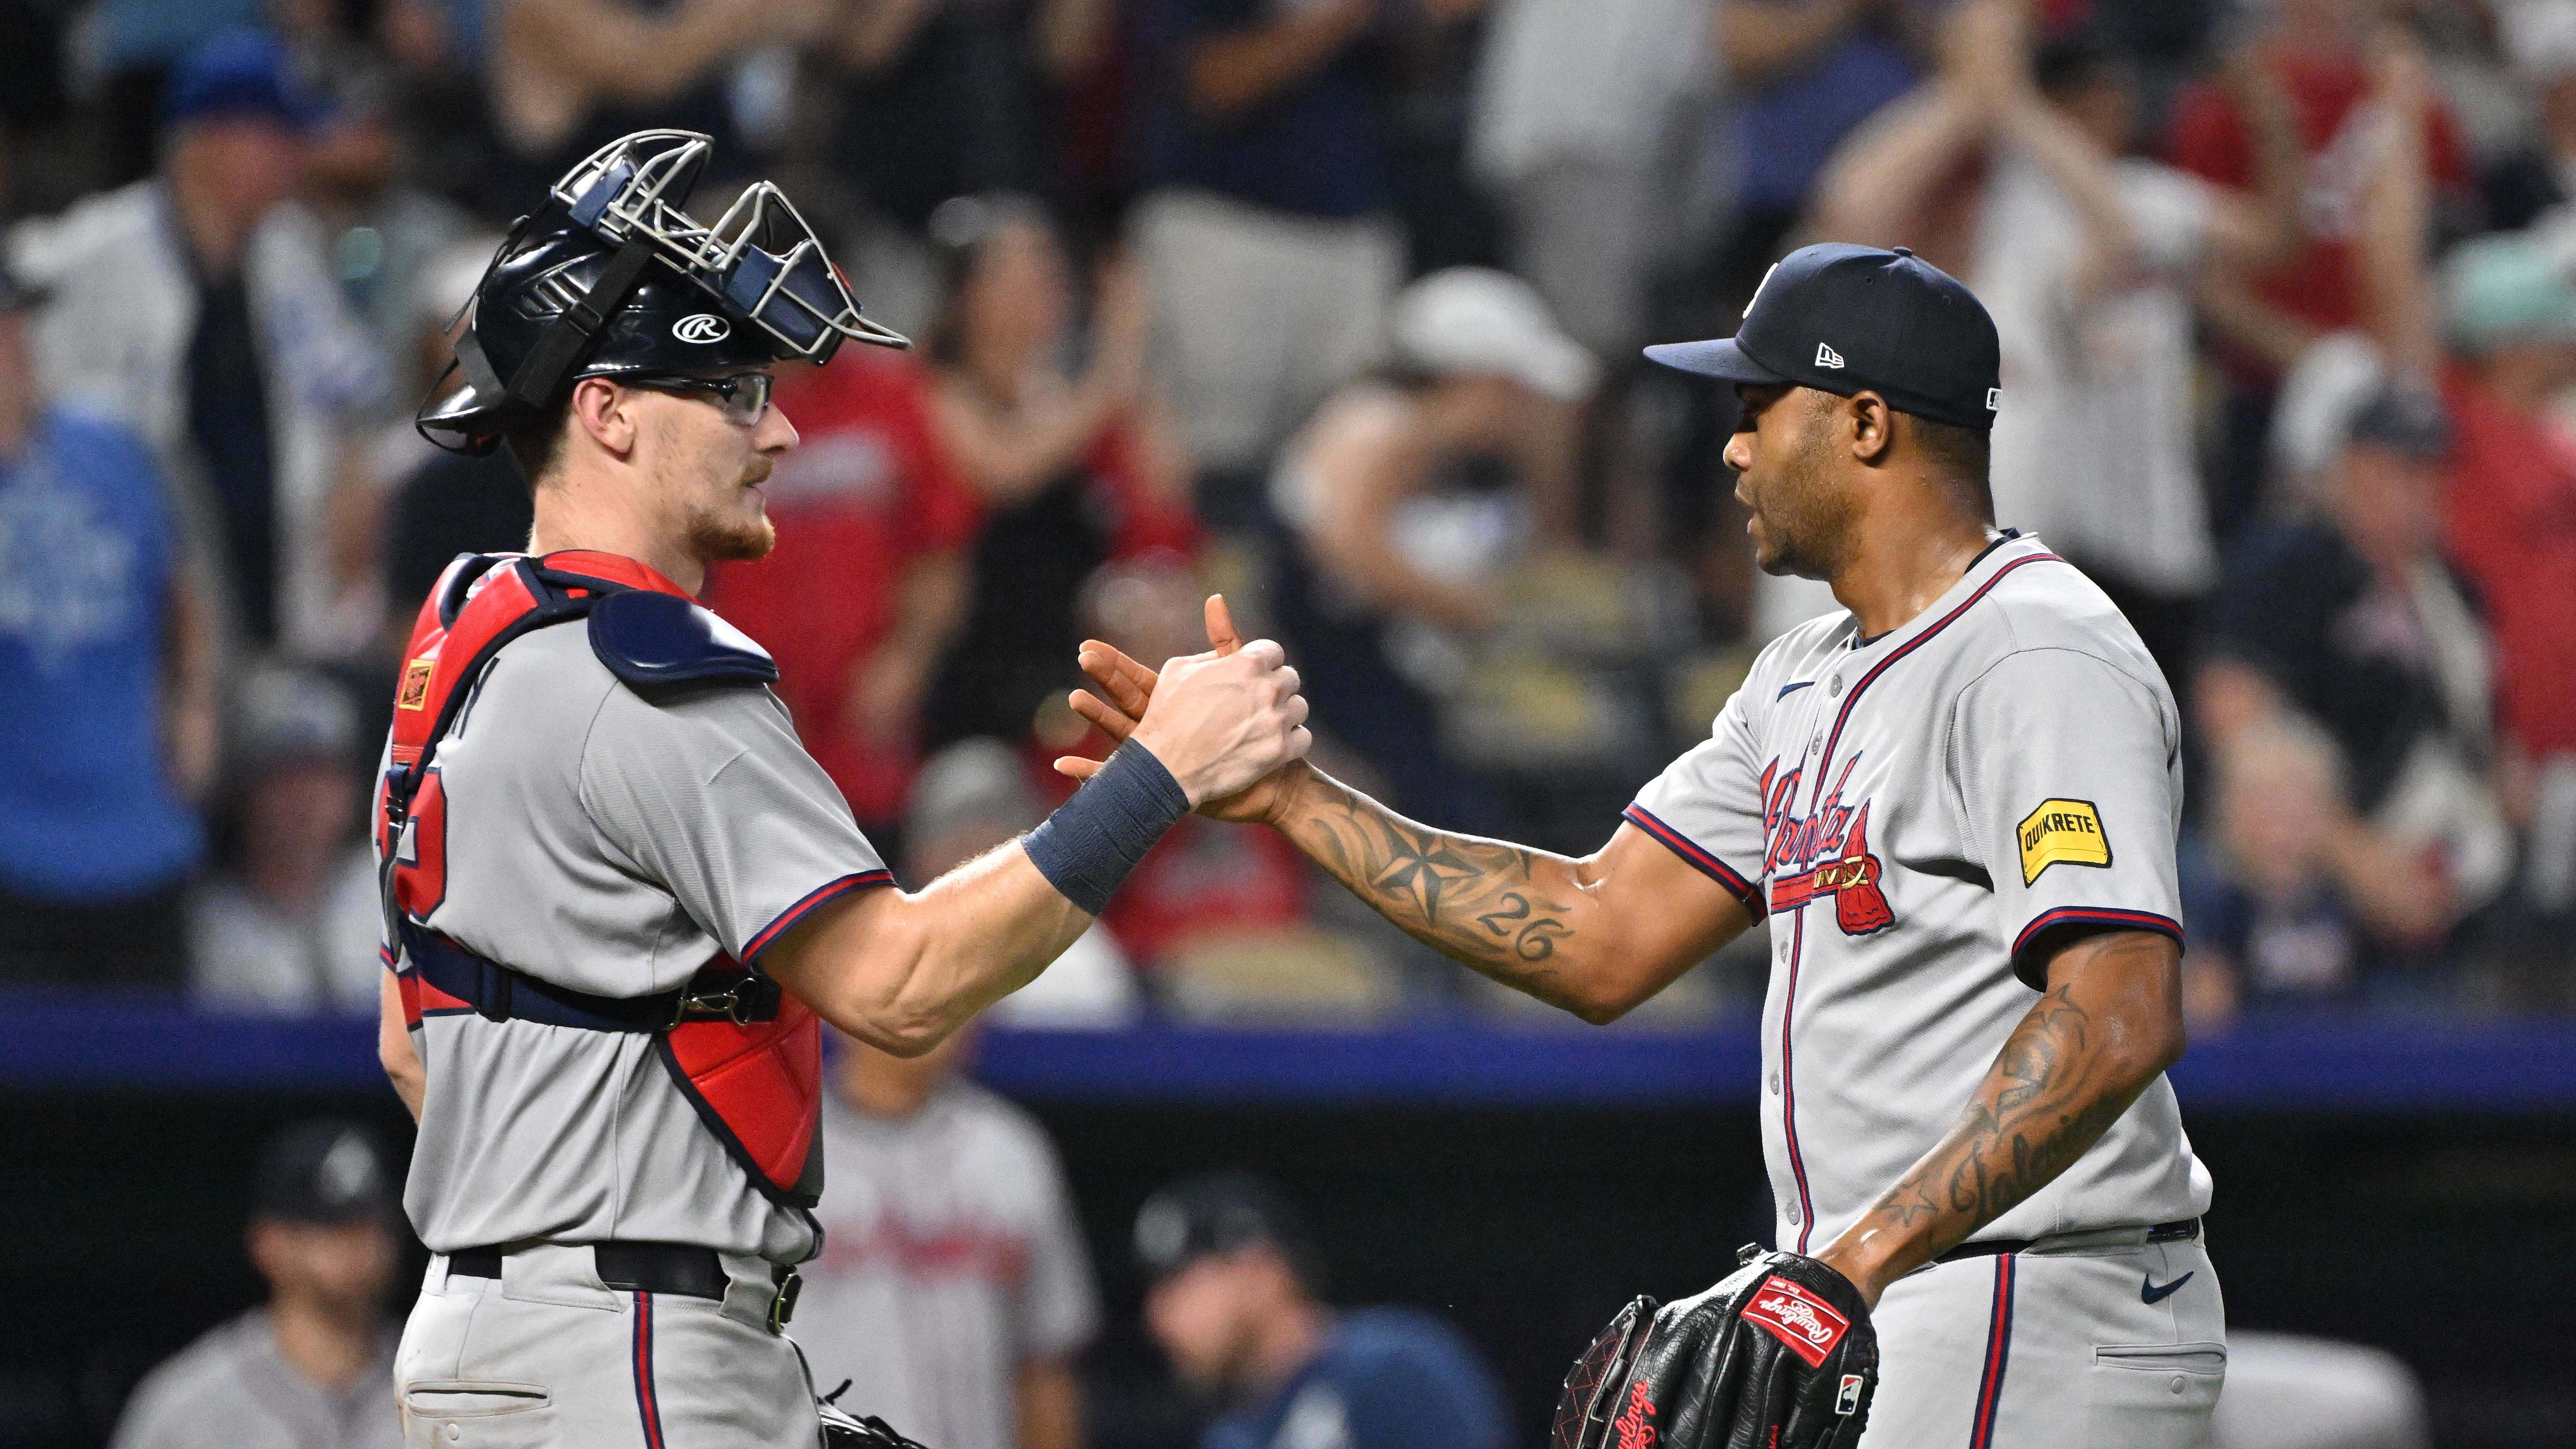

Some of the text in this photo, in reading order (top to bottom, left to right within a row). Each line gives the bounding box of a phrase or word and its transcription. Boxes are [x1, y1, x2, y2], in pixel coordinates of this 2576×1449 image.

[679, 316, 722, 341] R
[2025, 813, 2096, 852] QUIKRETE
[1476, 892, 1564, 962] 26
[1758, 1296, 1833, 1344] Rawlings
[1615, 1379, 1657, 1449] wlings
